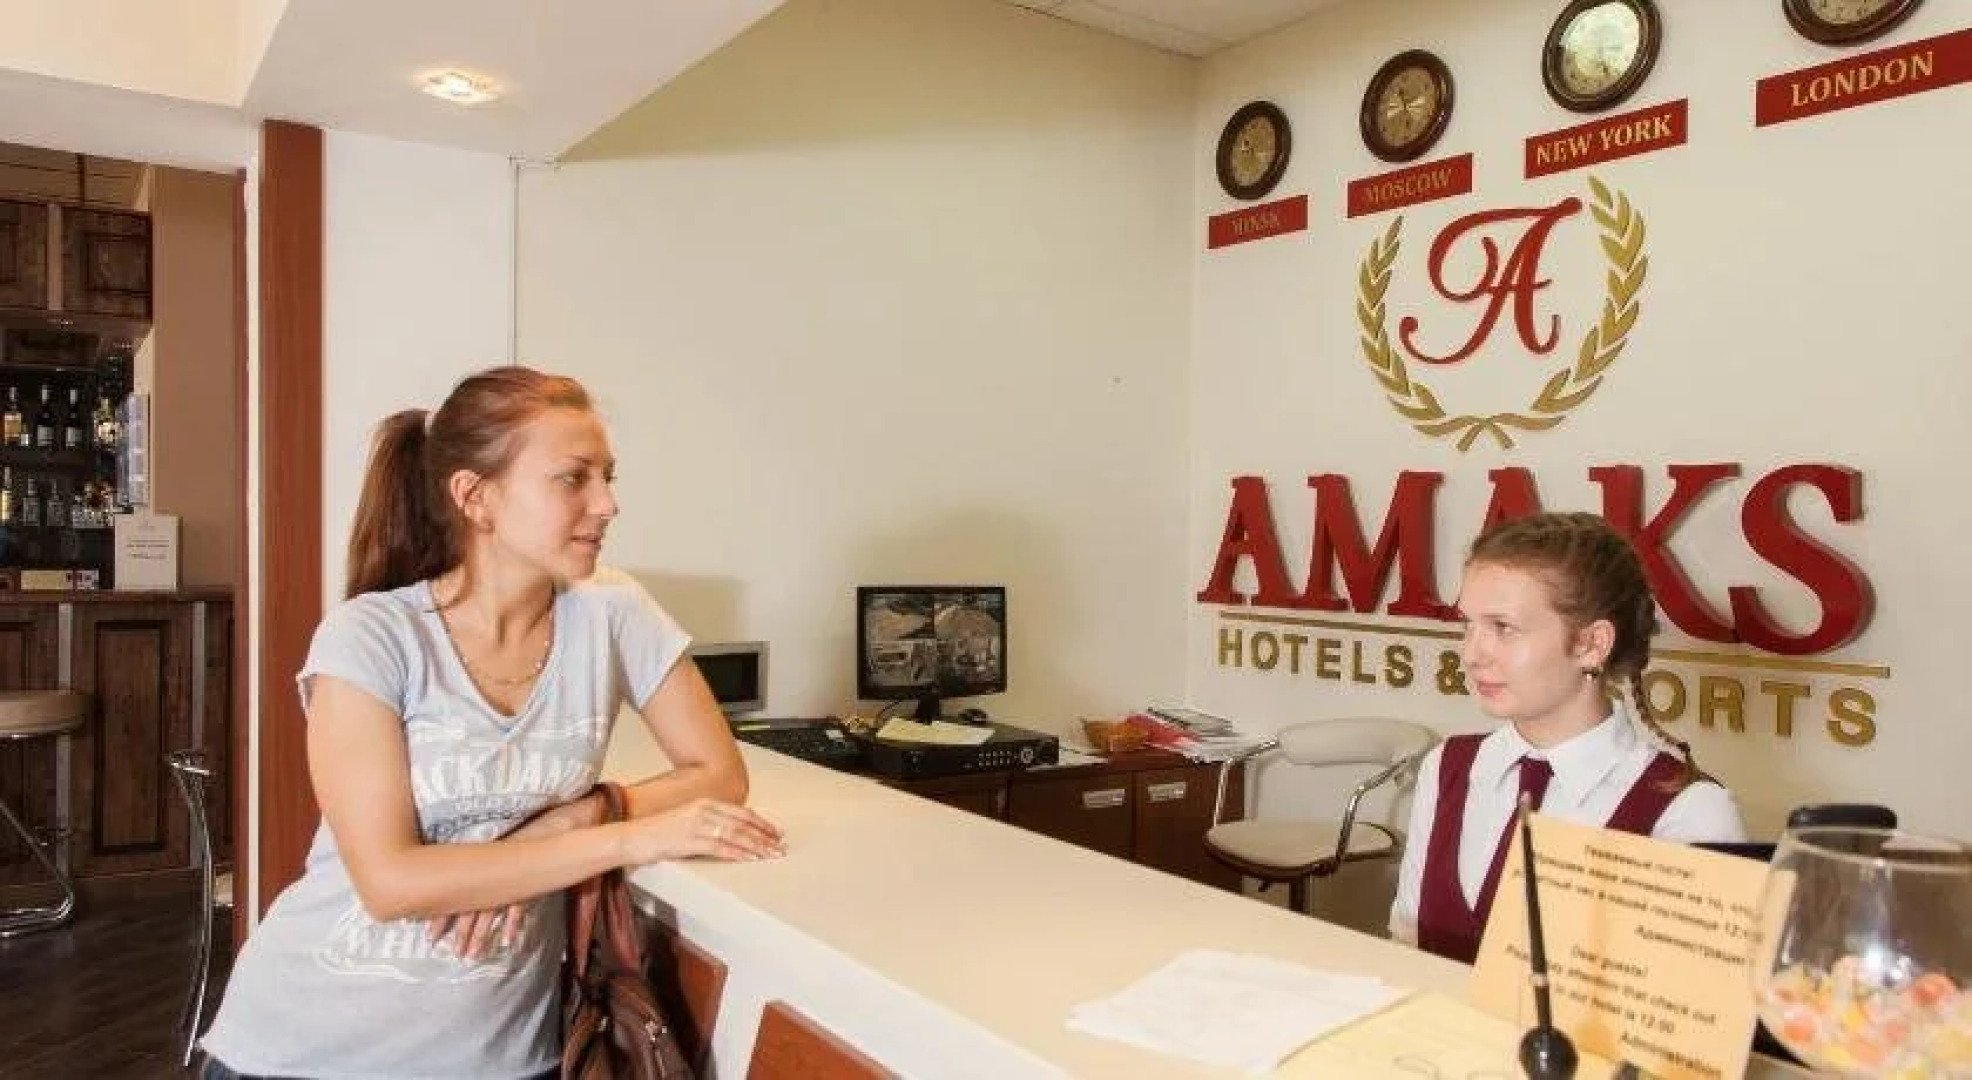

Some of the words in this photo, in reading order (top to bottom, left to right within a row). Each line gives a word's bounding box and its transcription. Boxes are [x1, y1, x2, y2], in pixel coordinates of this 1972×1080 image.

[1789, 51, 1935, 108] LONDON
[1536, 136, 1593, 166] NEW
[1599, 113, 1673, 153] YORK
[1364, 168, 1452, 204] MOSCOW
[1217, 628, 1415, 688] HOTELS
[1436, 650, 1470, 696] &
[1603, 667, 1878, 746] ORTS
